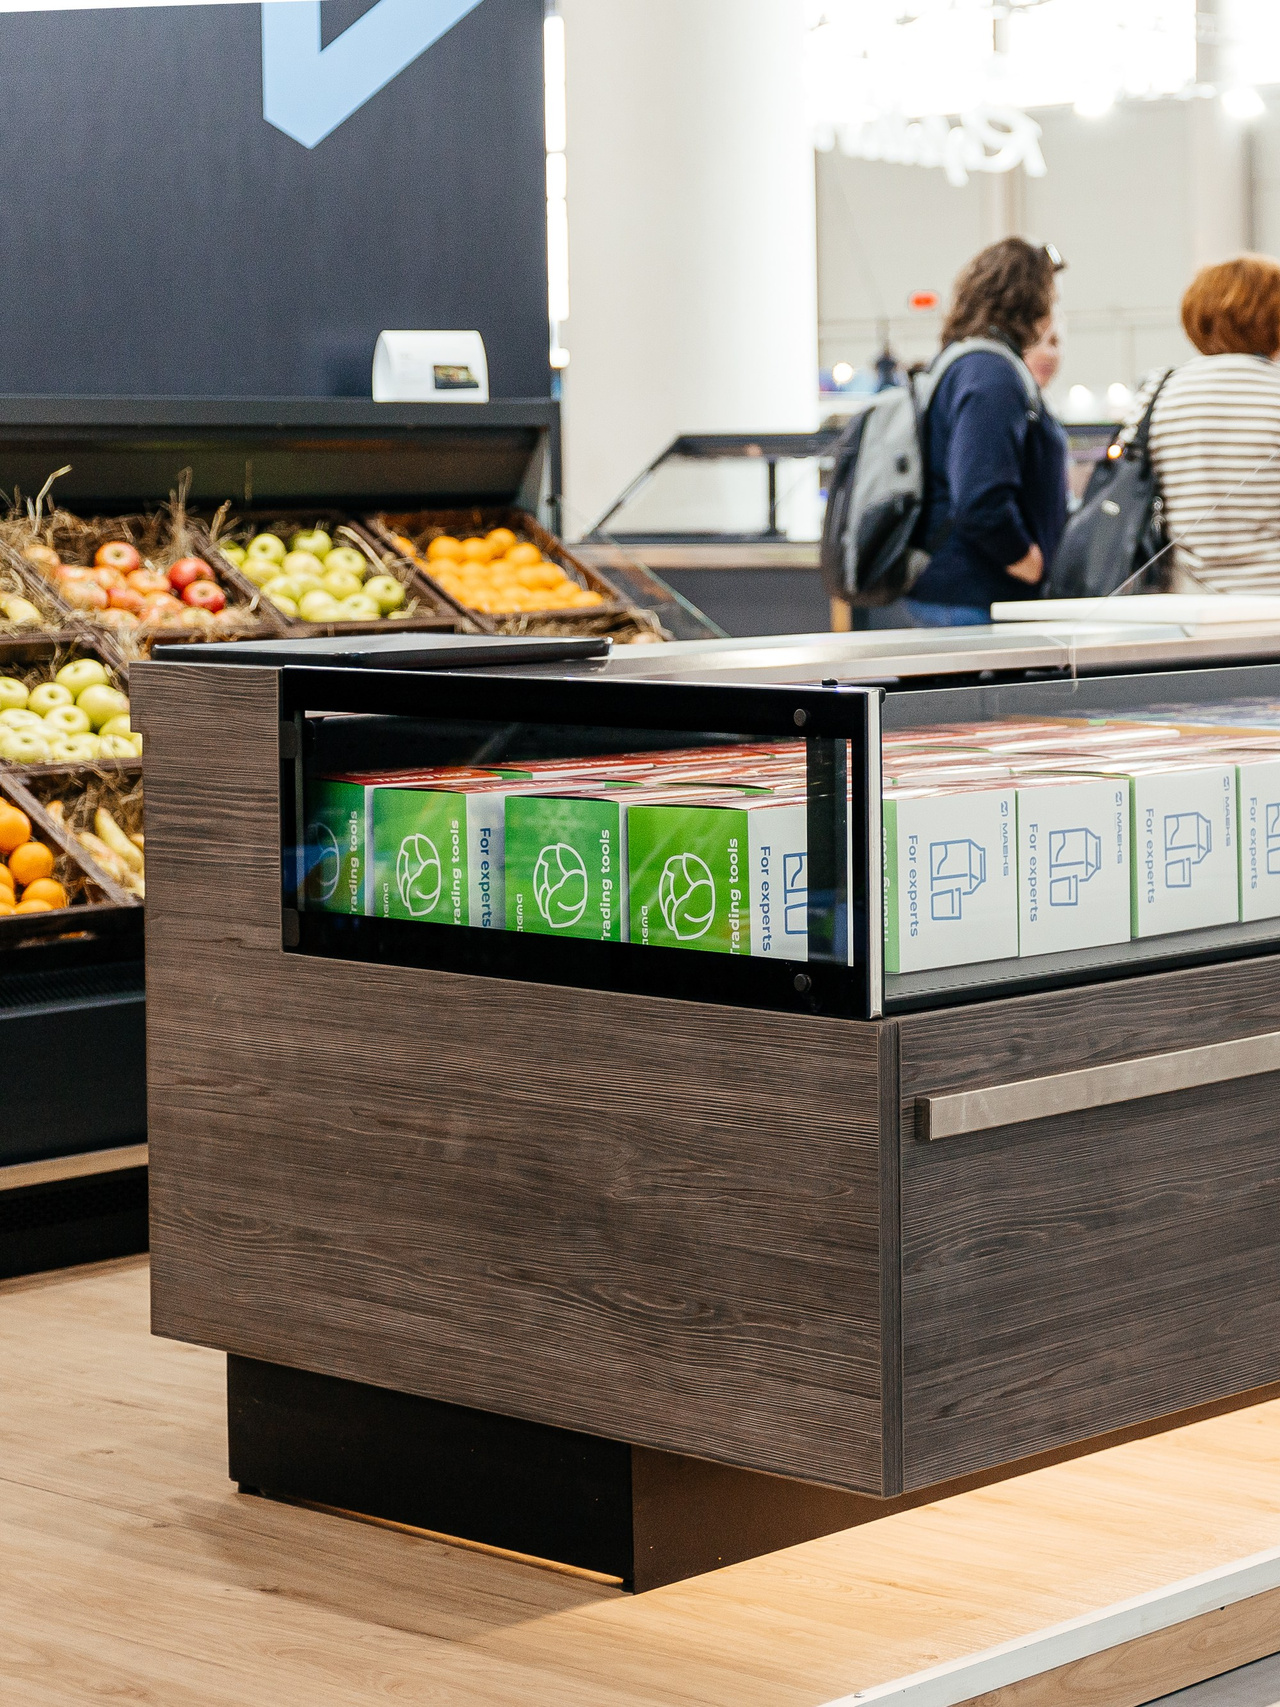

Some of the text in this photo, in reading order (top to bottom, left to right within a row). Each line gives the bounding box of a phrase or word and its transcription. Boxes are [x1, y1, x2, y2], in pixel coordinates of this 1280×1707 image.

[349, 811, 359, 914] rading tools
[450, 820, 462, 925] rading tools
[479, 828, 492, 927] For experts
[599, 829, 613, 940] rading tools
[728, 838, 738, 883] tools
[907, 835, 919, 937] For experts
[1028, 823, 1038, 922] For experts
[1145, 808, 1155, 903] For experts
[1249, 797, 1258, 889] For experts
[760, 846, 772, 951] For experts
